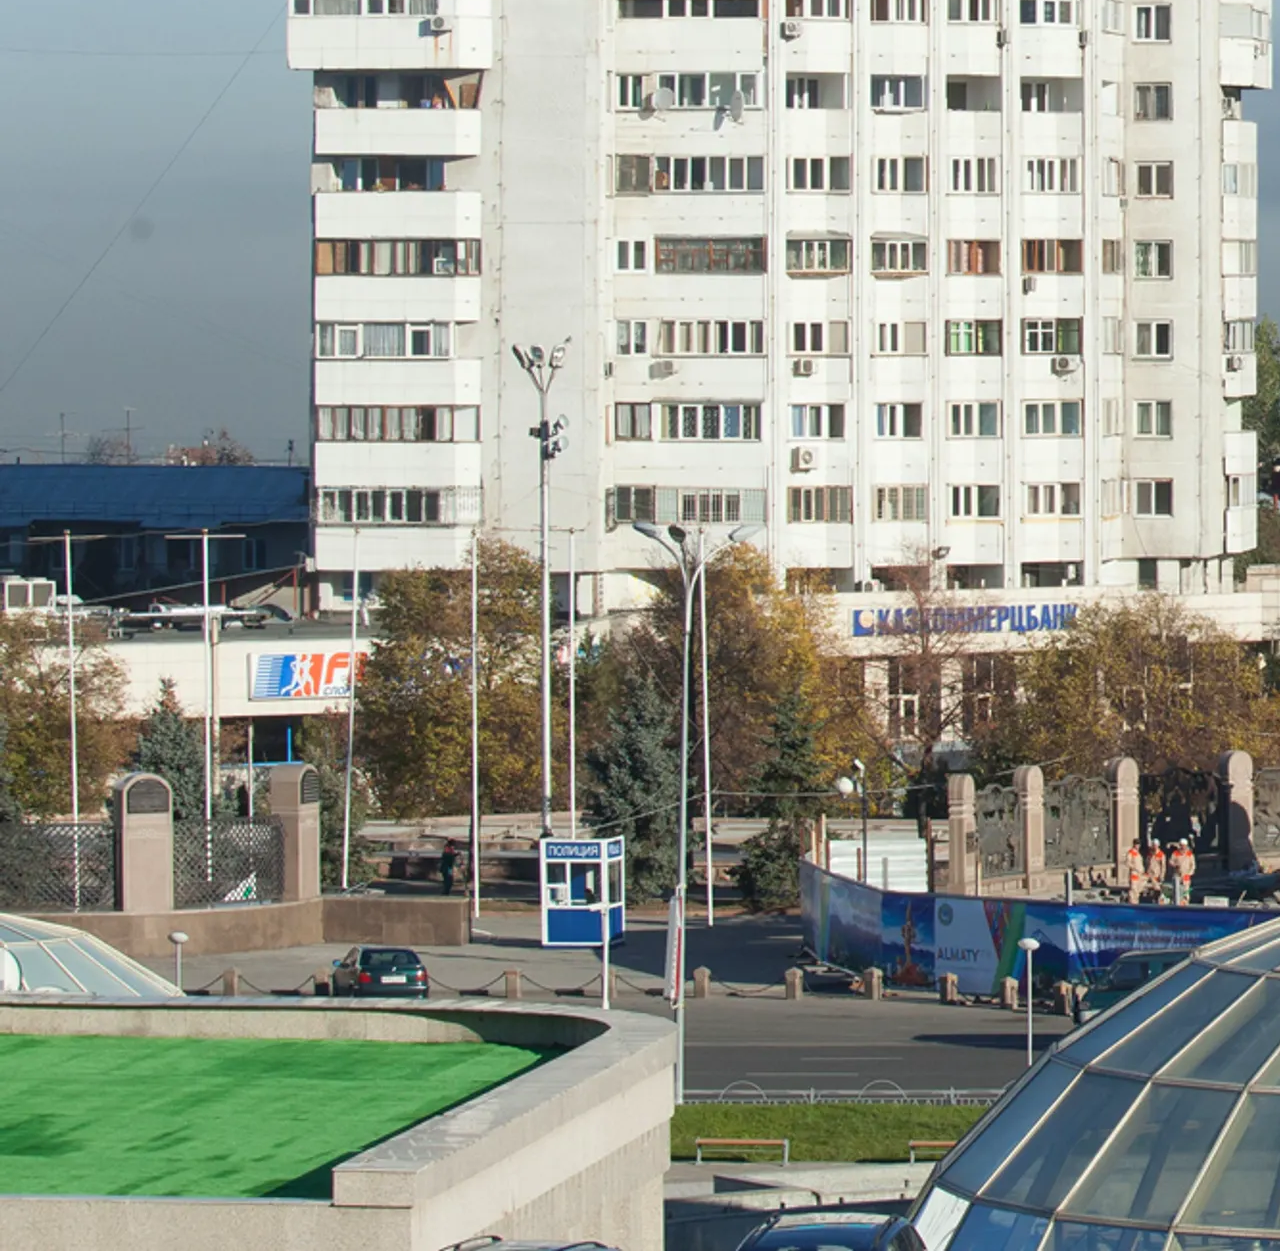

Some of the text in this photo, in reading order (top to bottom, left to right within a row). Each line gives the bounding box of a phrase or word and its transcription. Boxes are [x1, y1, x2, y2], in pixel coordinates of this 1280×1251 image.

[876, 603, 1077, 637] КАЗКОММЕРЦБАНК
[548, 844, 598, 857] ПОЛИЦИЯ
[937, 948, 982, 963] ALMATY
